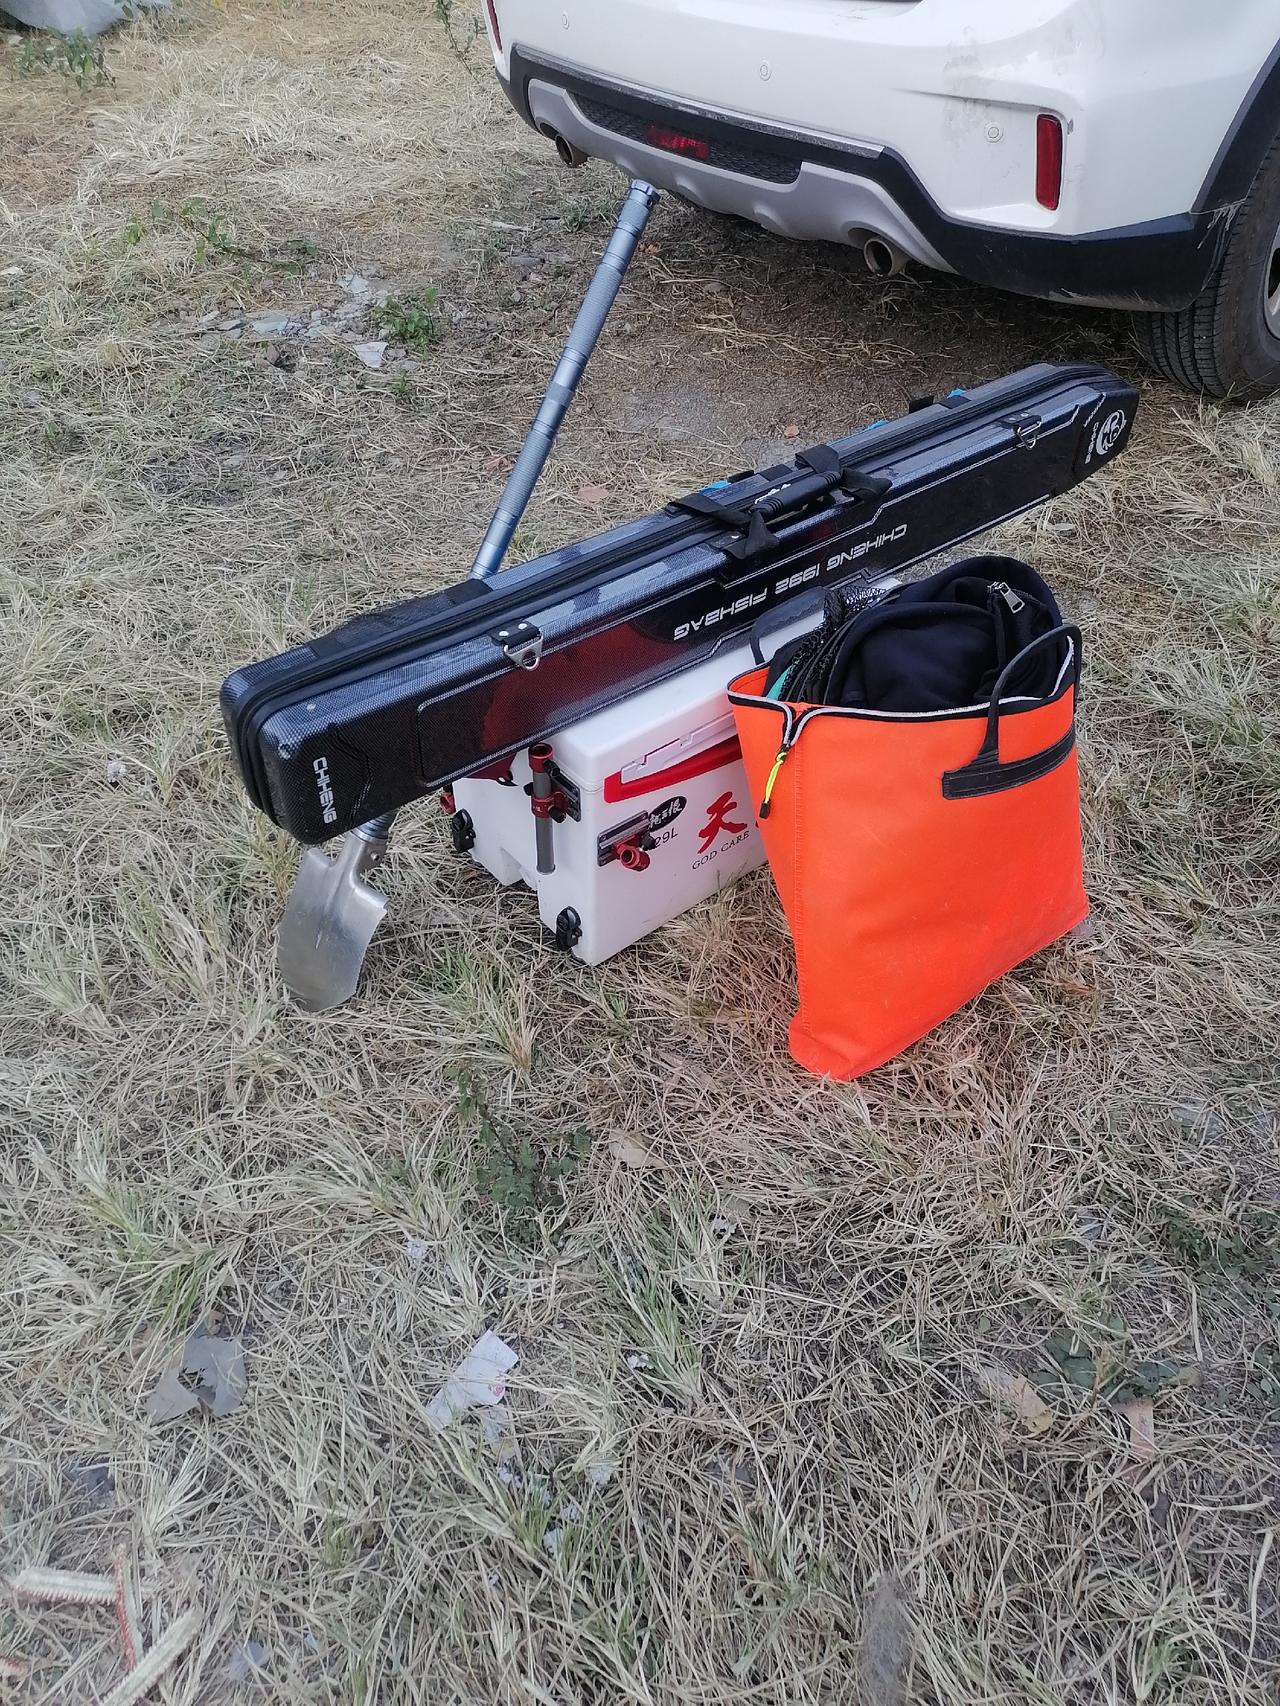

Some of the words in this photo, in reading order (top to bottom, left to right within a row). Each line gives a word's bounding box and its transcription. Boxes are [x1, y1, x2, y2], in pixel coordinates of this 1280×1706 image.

[826, 524, 908, 572] CHIHENG
[775, 564, 820, 595] 1992
[673, 587, 768, 641] FISHBAG
[313, 757, 338, 824] CHIHENG
[697, 791, 759, 854] 天
[692, 850, 718, 870] GOD
